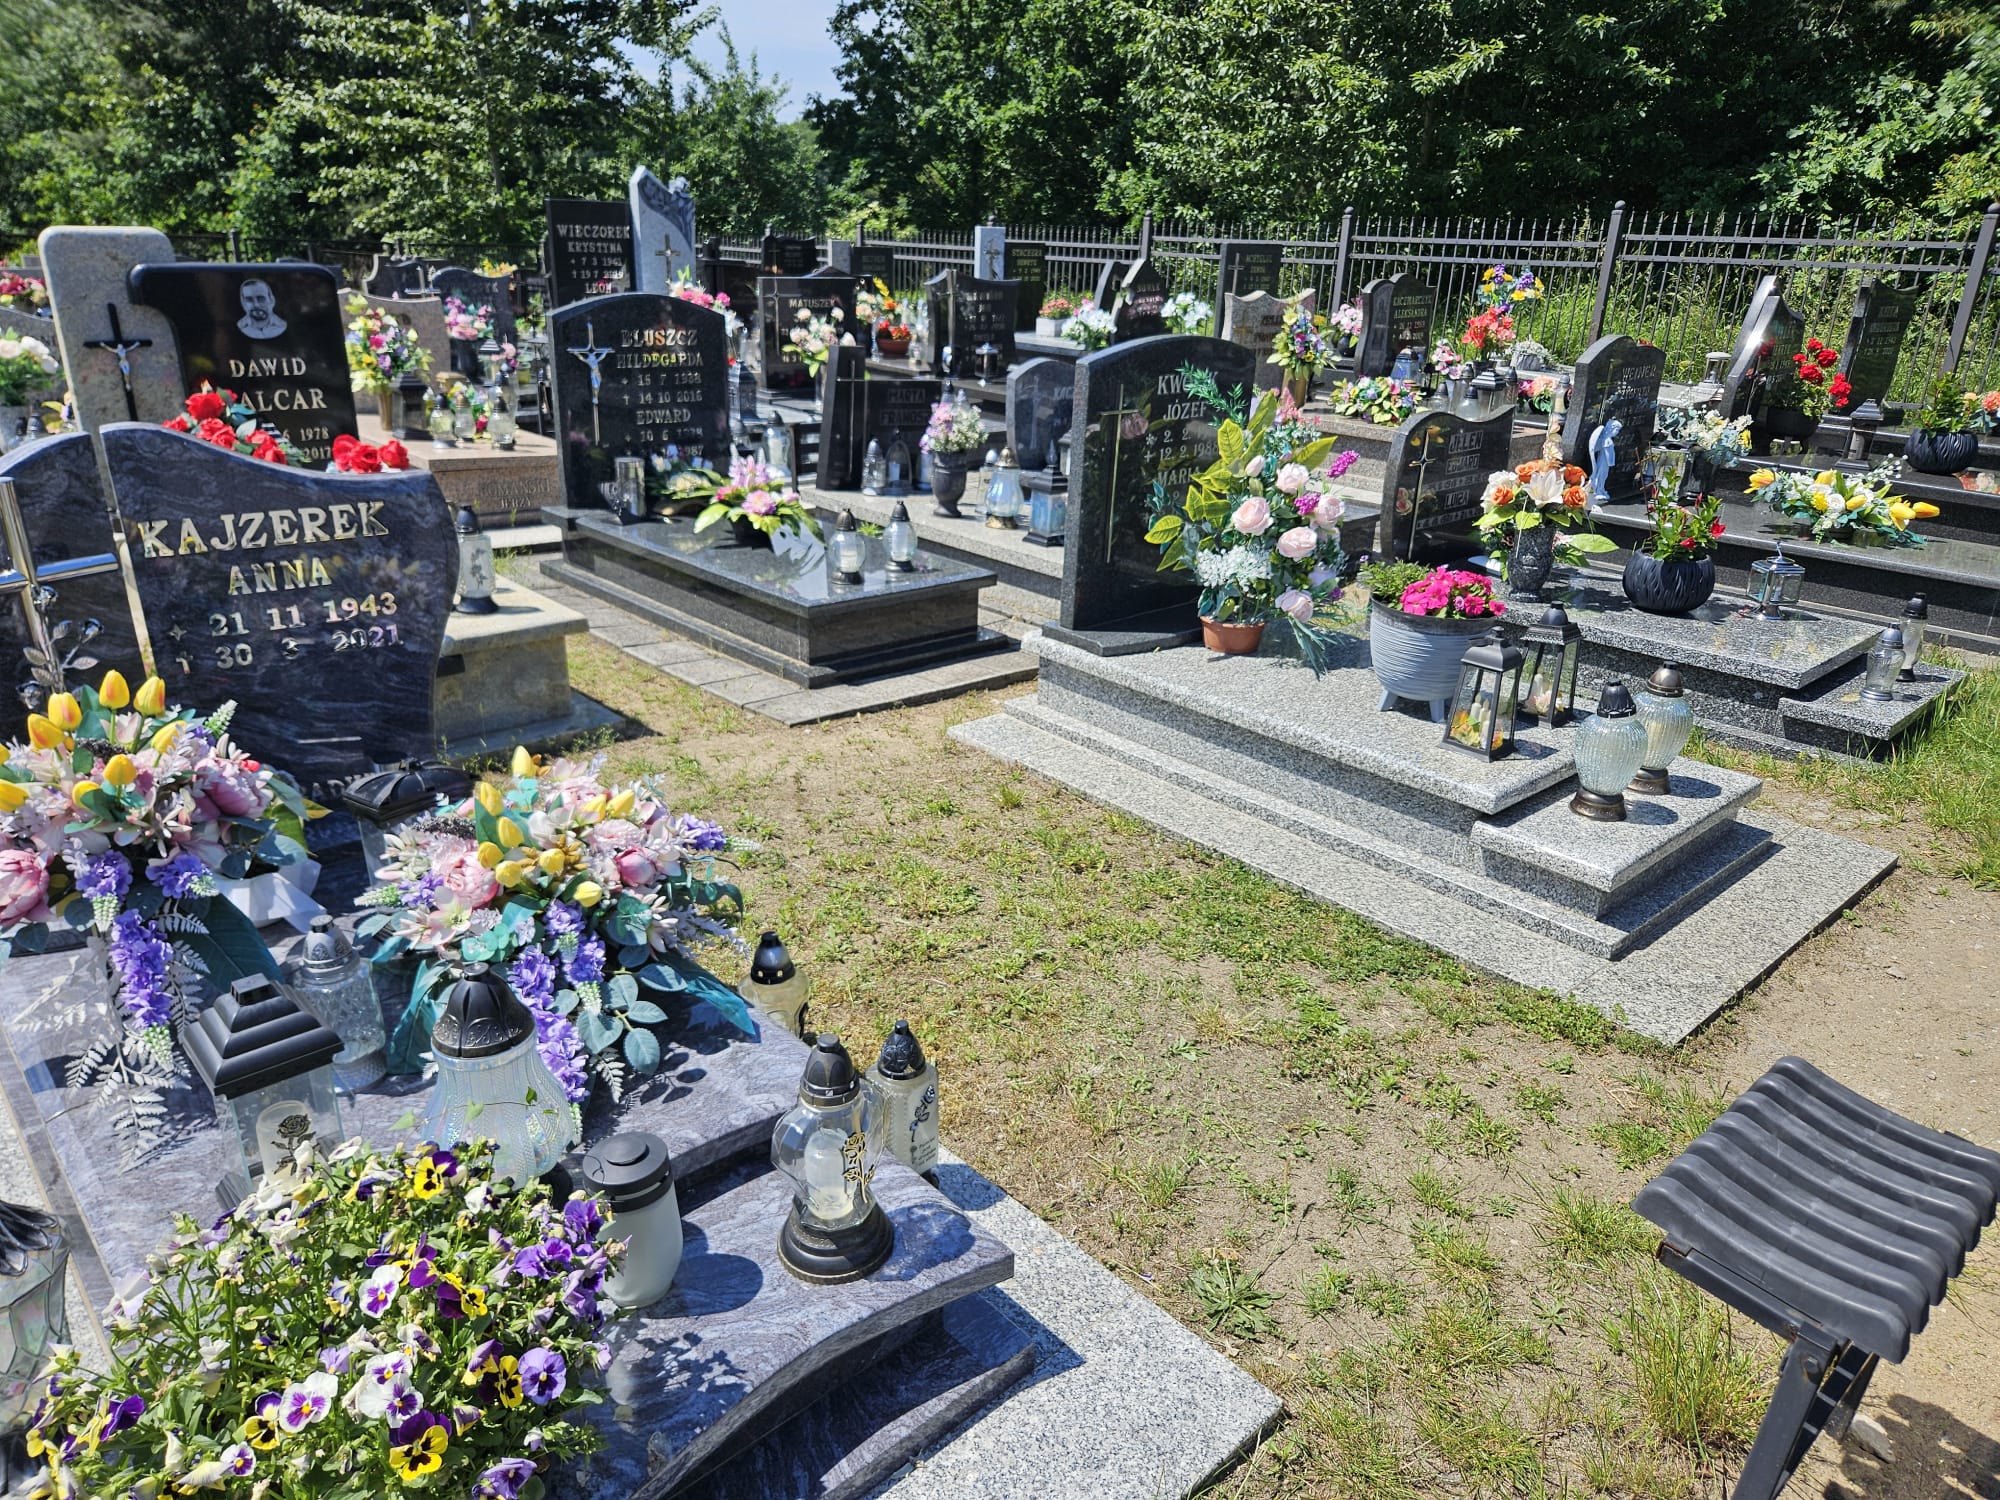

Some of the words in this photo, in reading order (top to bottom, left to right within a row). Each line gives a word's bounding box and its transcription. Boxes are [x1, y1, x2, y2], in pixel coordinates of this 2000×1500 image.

[556, 224, 630, 239] WIECZOREK
[568, 241, 623, 253] KRYSTYNA
[228, 356, 307, 378] DAWID
[616, 351, 704, 368] HILDEGARDA
[637, 374, 651, 387] 15
[660, 374, 667, 386] 7
[240, 387, 328, 412] ALCAR
[639, 392, 653, 405] 14
[658, 391, 671, 404] 10
[635, 408, 692, 425] EDWARD
[1163, 398, 1209, 421] JÓZEF
[300, 426, 330, 442] 1978
[304, 447, 332, 459] 2017
[137, 500, 389, 559] KAJZEREK
[227, 556, 333, 596] ANNA
[209, 611, 251, 638] 21
[266, 603, 307, 631] 11
[322, 592, 399, 624] 1943
[215, 642, 254, 669] 30
[281, 636, 300, 660] 3
[332, 623, 405, 653] 2021
